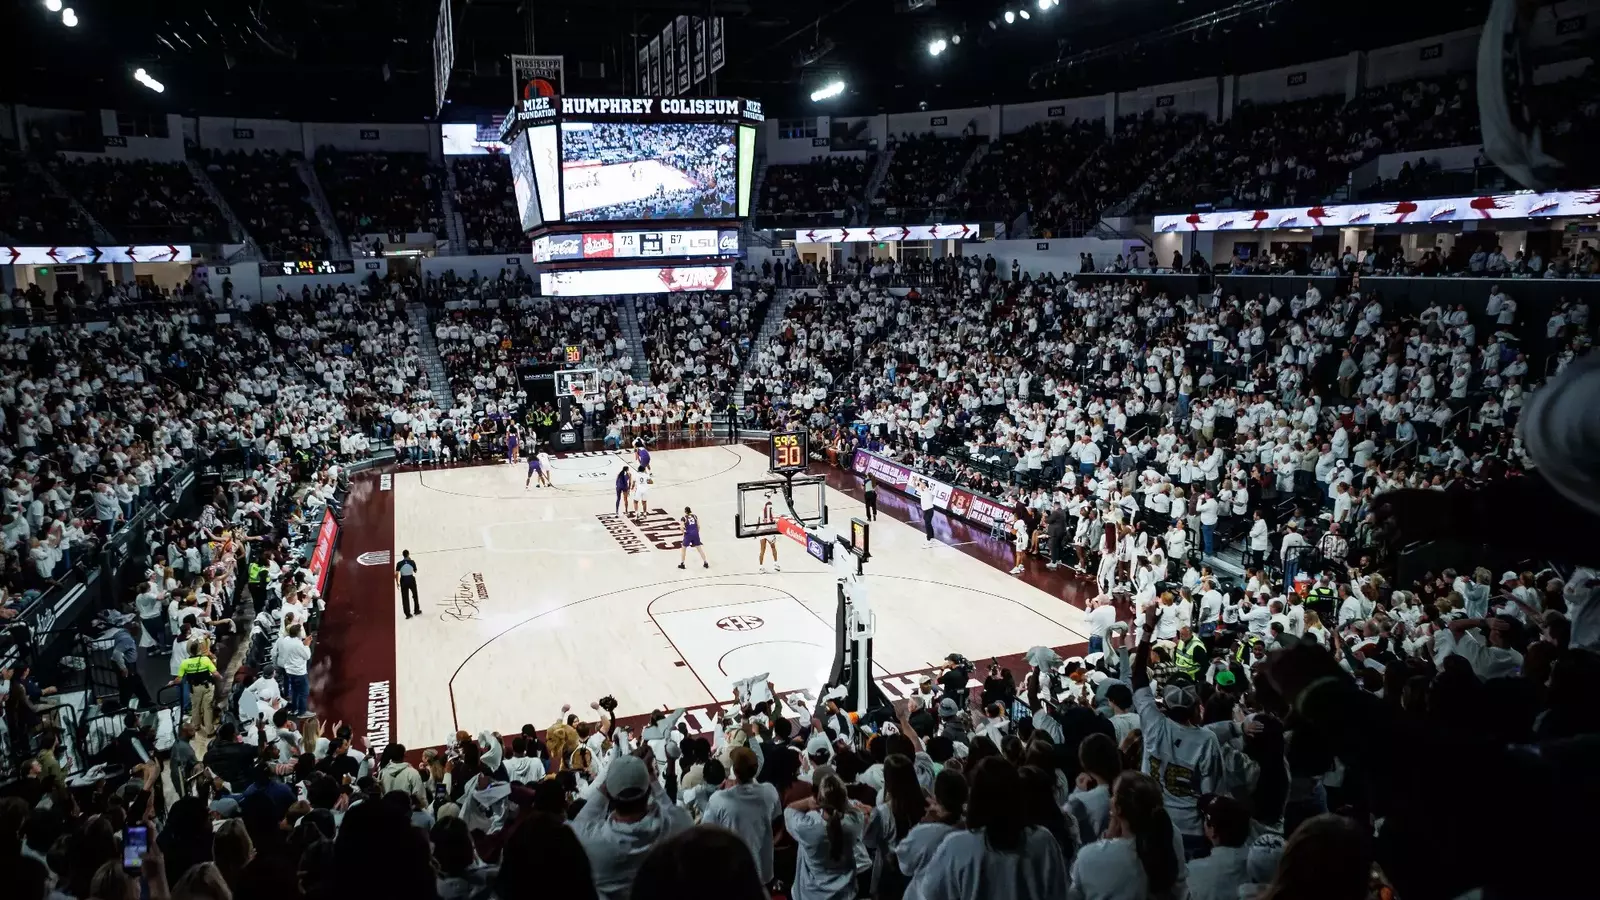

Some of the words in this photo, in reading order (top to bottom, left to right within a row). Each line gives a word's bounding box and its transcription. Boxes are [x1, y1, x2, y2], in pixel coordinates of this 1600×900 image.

[523, 97, 549, 113] MIZE
[561, 98, 653, 114] HUMPHREY
[660, 99, 738, 115] COLISEUM
[745, 99, 761, 114] MIZE
[518, 108, 556, 121] FOUNDATION
[621, 235, 633, 248] 73
[670, 234, 682, 247] 67
[689, 238, 717, 253] LSU
[567, 351, 580, 362] 30
[778, 446, 801, 467] 30
[936, 490, 950, 503] LSU
